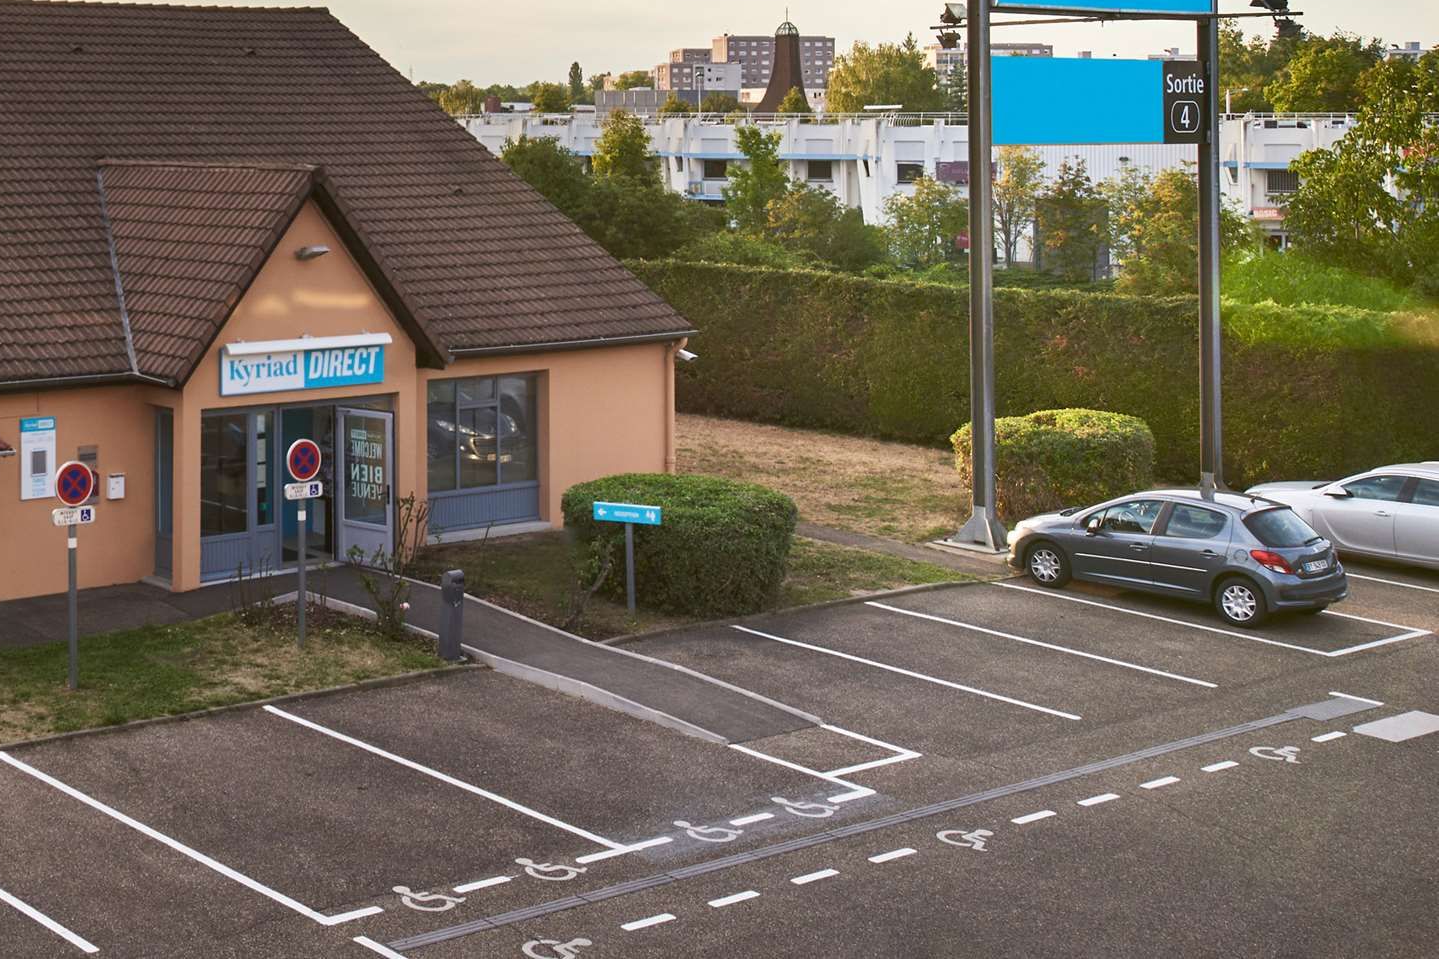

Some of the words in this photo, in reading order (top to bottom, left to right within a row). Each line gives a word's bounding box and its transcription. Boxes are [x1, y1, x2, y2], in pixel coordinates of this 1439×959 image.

[1166, 73, 1204, 93] Sortie
[1180, 105, 1191, 128] 4
[230, 353, 298, 386] Kyriad
[309, 347, 380, 379] DIRECT
